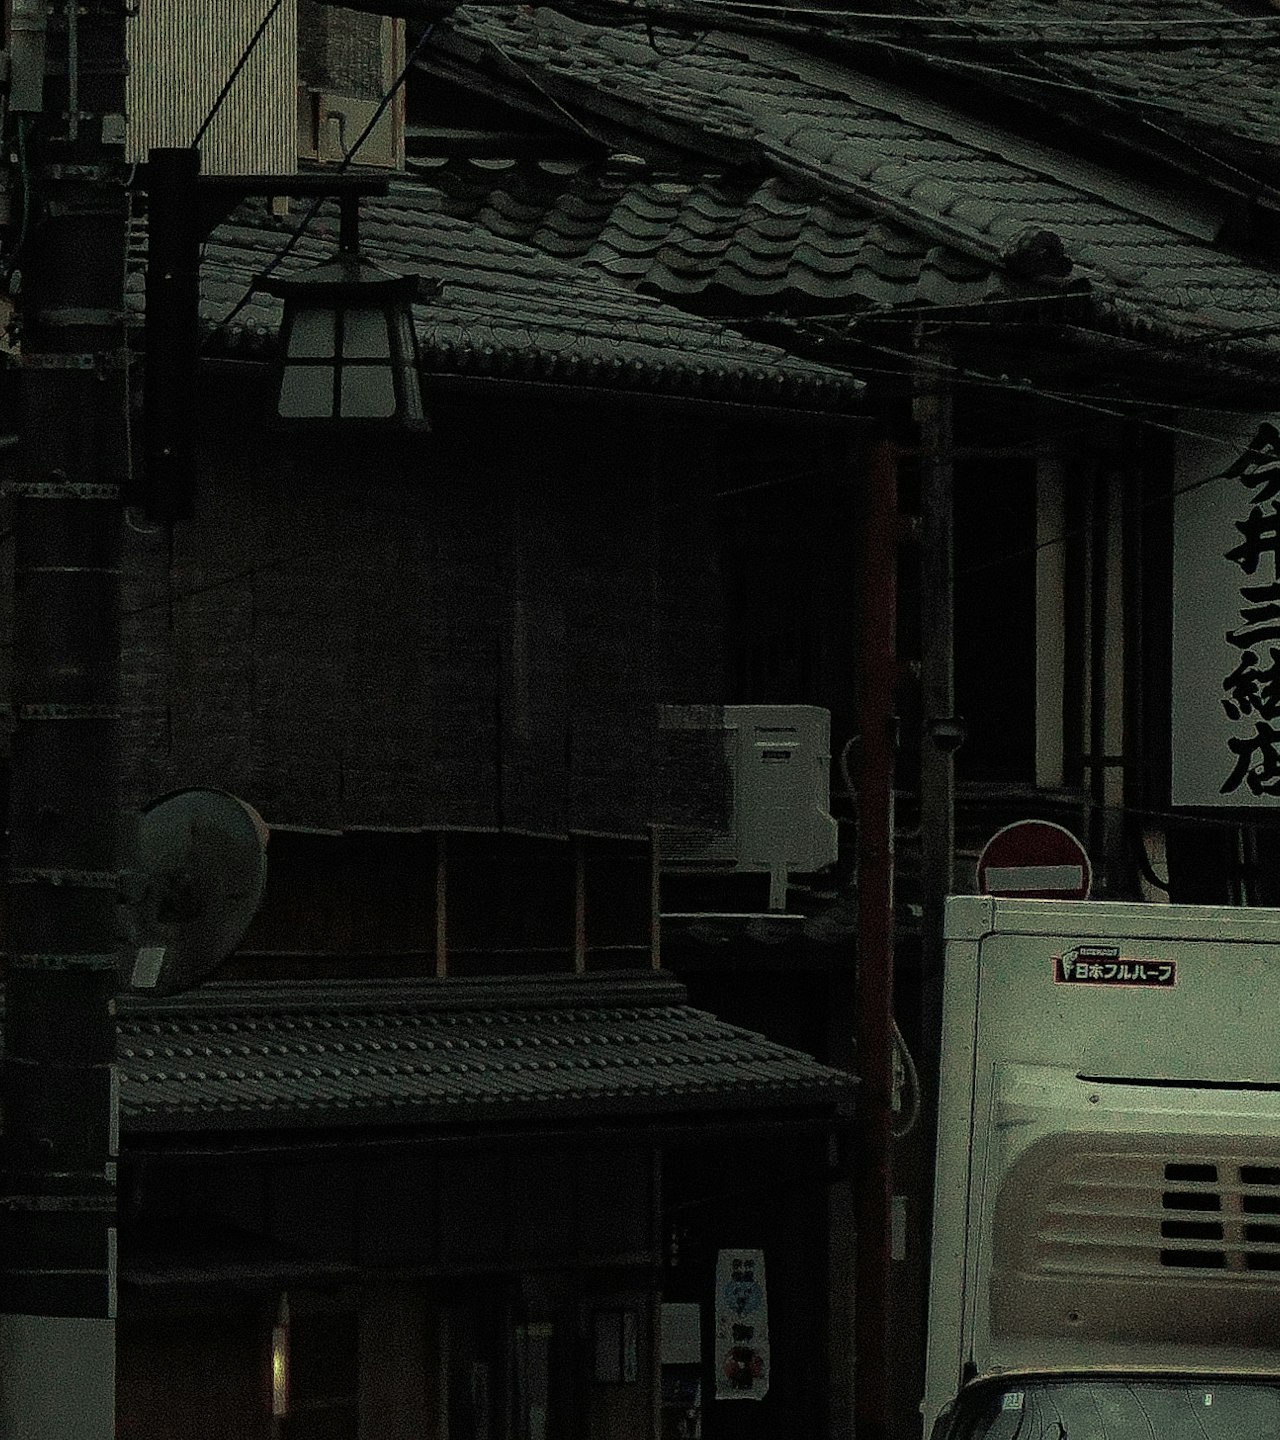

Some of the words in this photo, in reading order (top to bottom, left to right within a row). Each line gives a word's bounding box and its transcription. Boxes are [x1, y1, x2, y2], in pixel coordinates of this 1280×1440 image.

[1075, 962, 1172, 982] 日本フルハーフ
